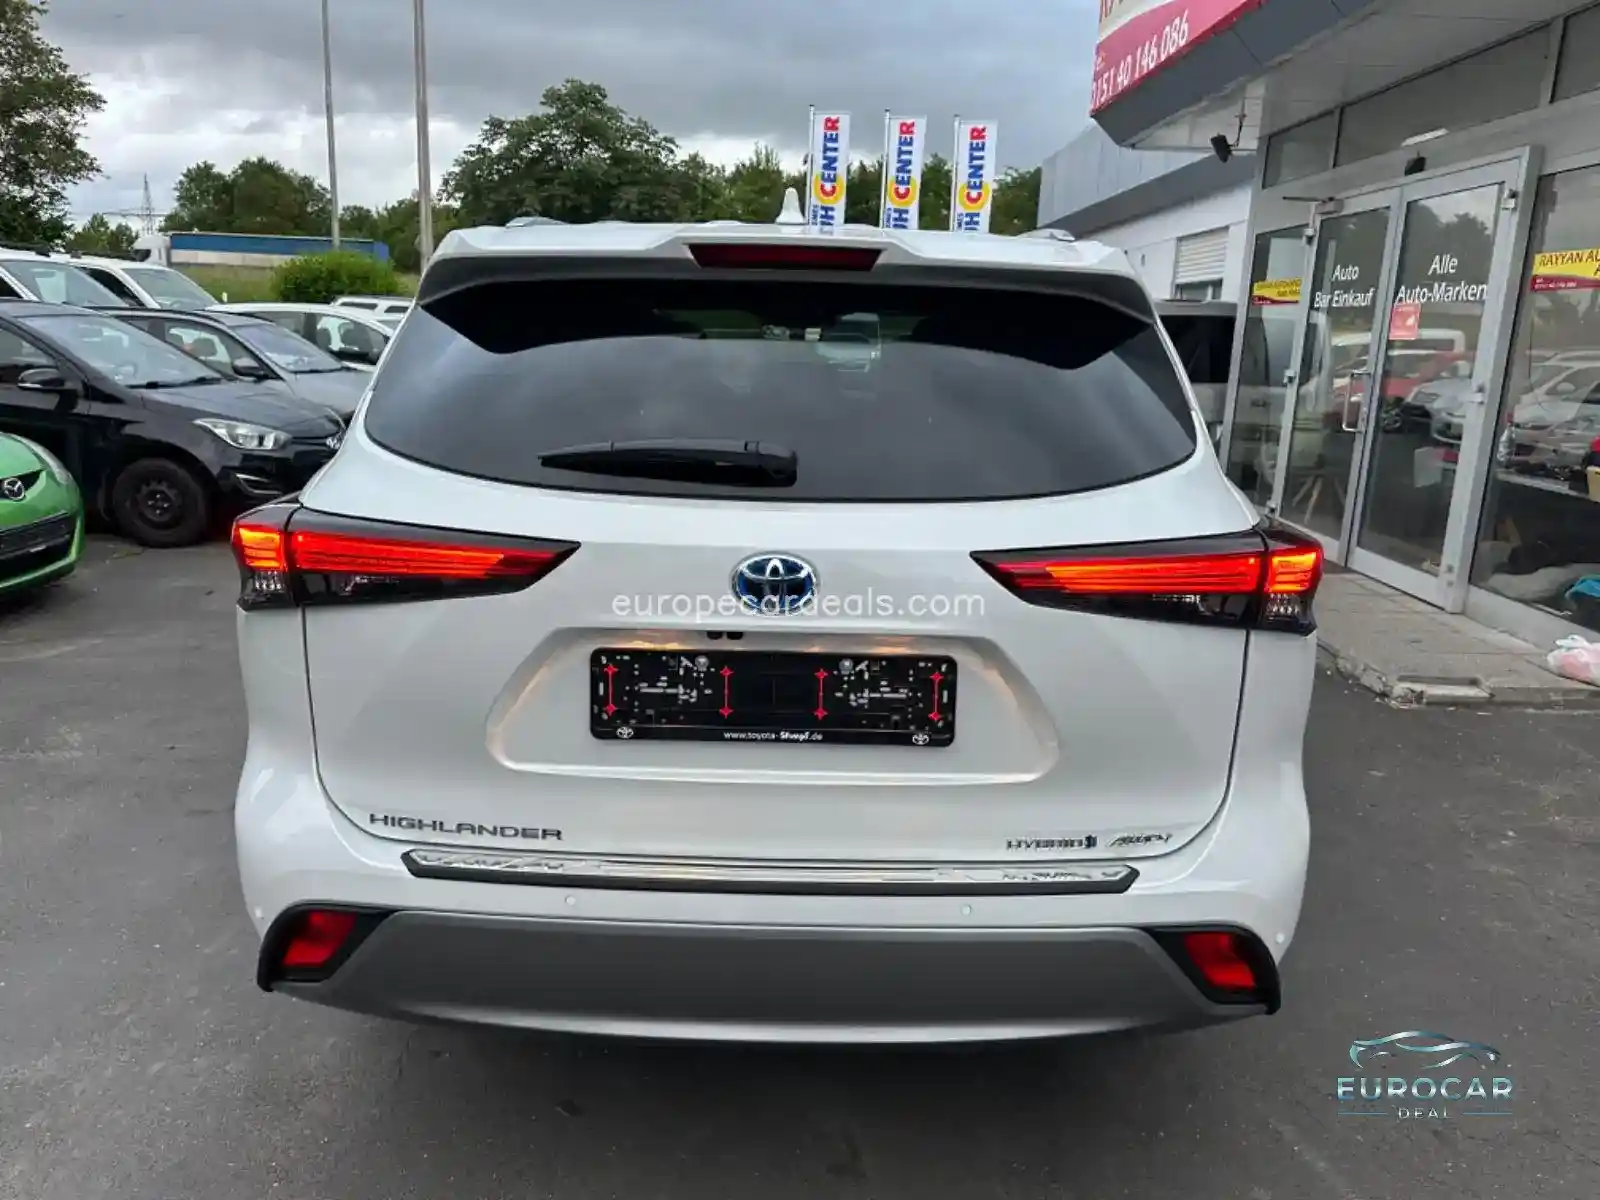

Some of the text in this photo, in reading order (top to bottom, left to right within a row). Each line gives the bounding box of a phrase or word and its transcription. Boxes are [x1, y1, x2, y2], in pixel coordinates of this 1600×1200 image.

[820, 116, 840, 197] CENTER
[895, 120, 916, 200] CENTER
[966, 124, 986, 204] CENTER
[1332, 264, 1360, 281] Auto
[1428, 254, 1459, 276] Alle
[1314, 287, 1375, 308] Bar Einkauf
[1395, 281, 1488, 305] Auto-Marken
[369, 813, 564, 841] HIGHLANDER
